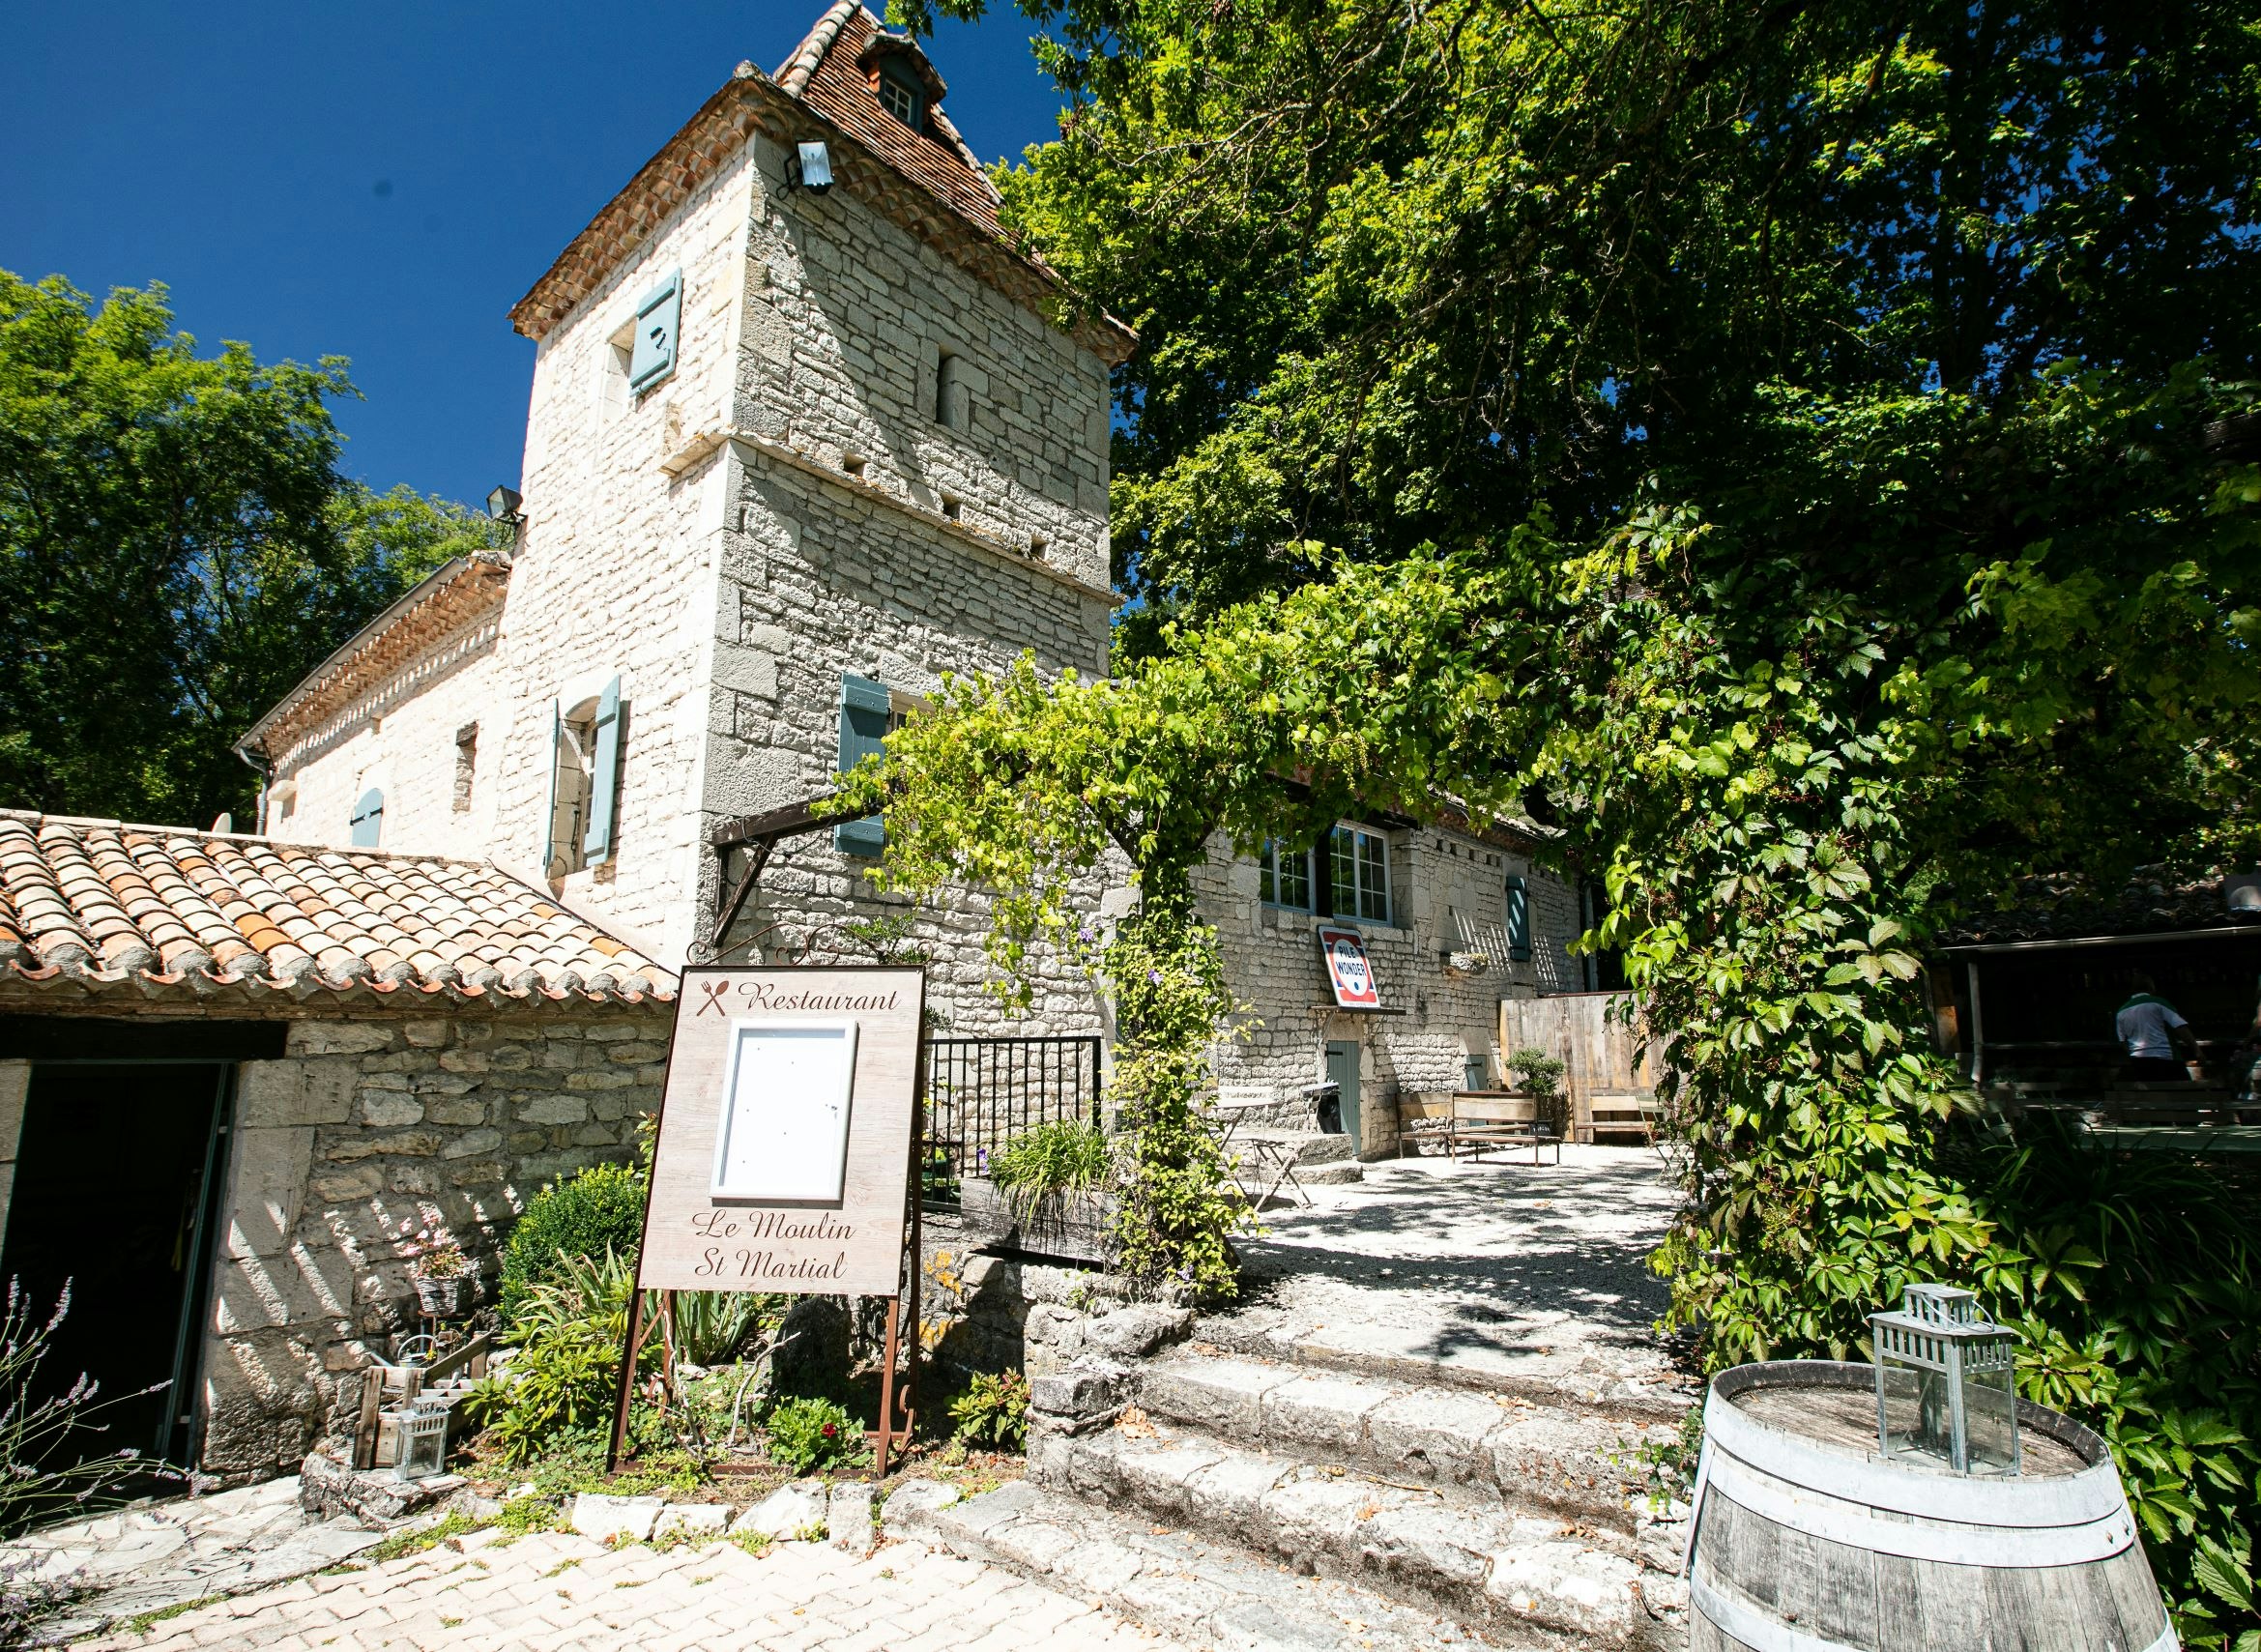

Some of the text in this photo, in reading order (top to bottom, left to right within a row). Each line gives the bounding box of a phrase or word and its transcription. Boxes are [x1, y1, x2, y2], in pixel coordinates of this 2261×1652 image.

[1339, 946, 1356, 958] PILE
[1336, 962, 1367, 975] WONDER
[738, 981, 901, 1010] Restaurant
[692, 1208, 857, 1240] Le Moulin
[694, 1247, 847, 1280] St Martial
